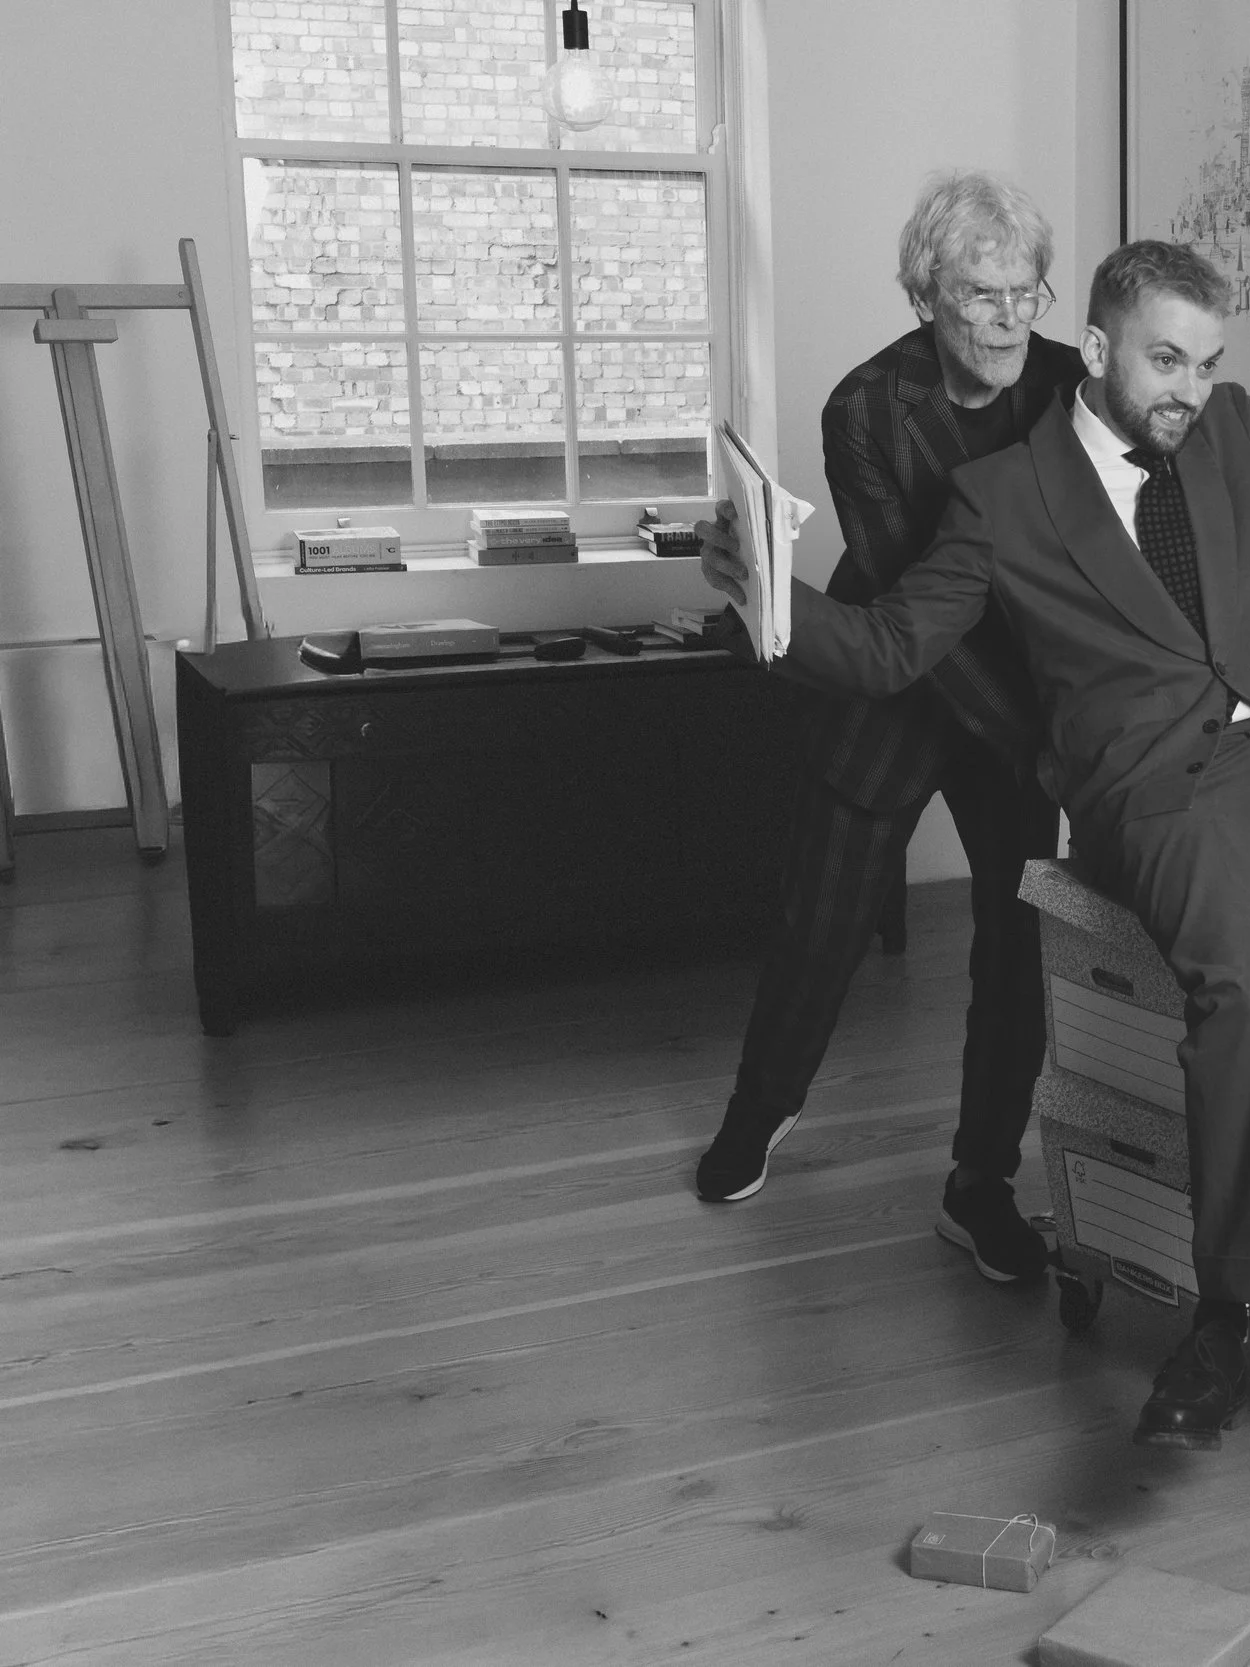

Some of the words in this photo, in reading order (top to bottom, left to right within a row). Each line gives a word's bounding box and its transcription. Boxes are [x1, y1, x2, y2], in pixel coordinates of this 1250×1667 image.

[519, 536, 541, 545] very
[542, 535, 562, 543] idea
[308, 546, 330, 555] 1001
[299, 566, 335, 574] Culture-Led
[1116, 1261, 1154, 1286] BANKERS
[1154, 1279, 1173, 1295] BOX
